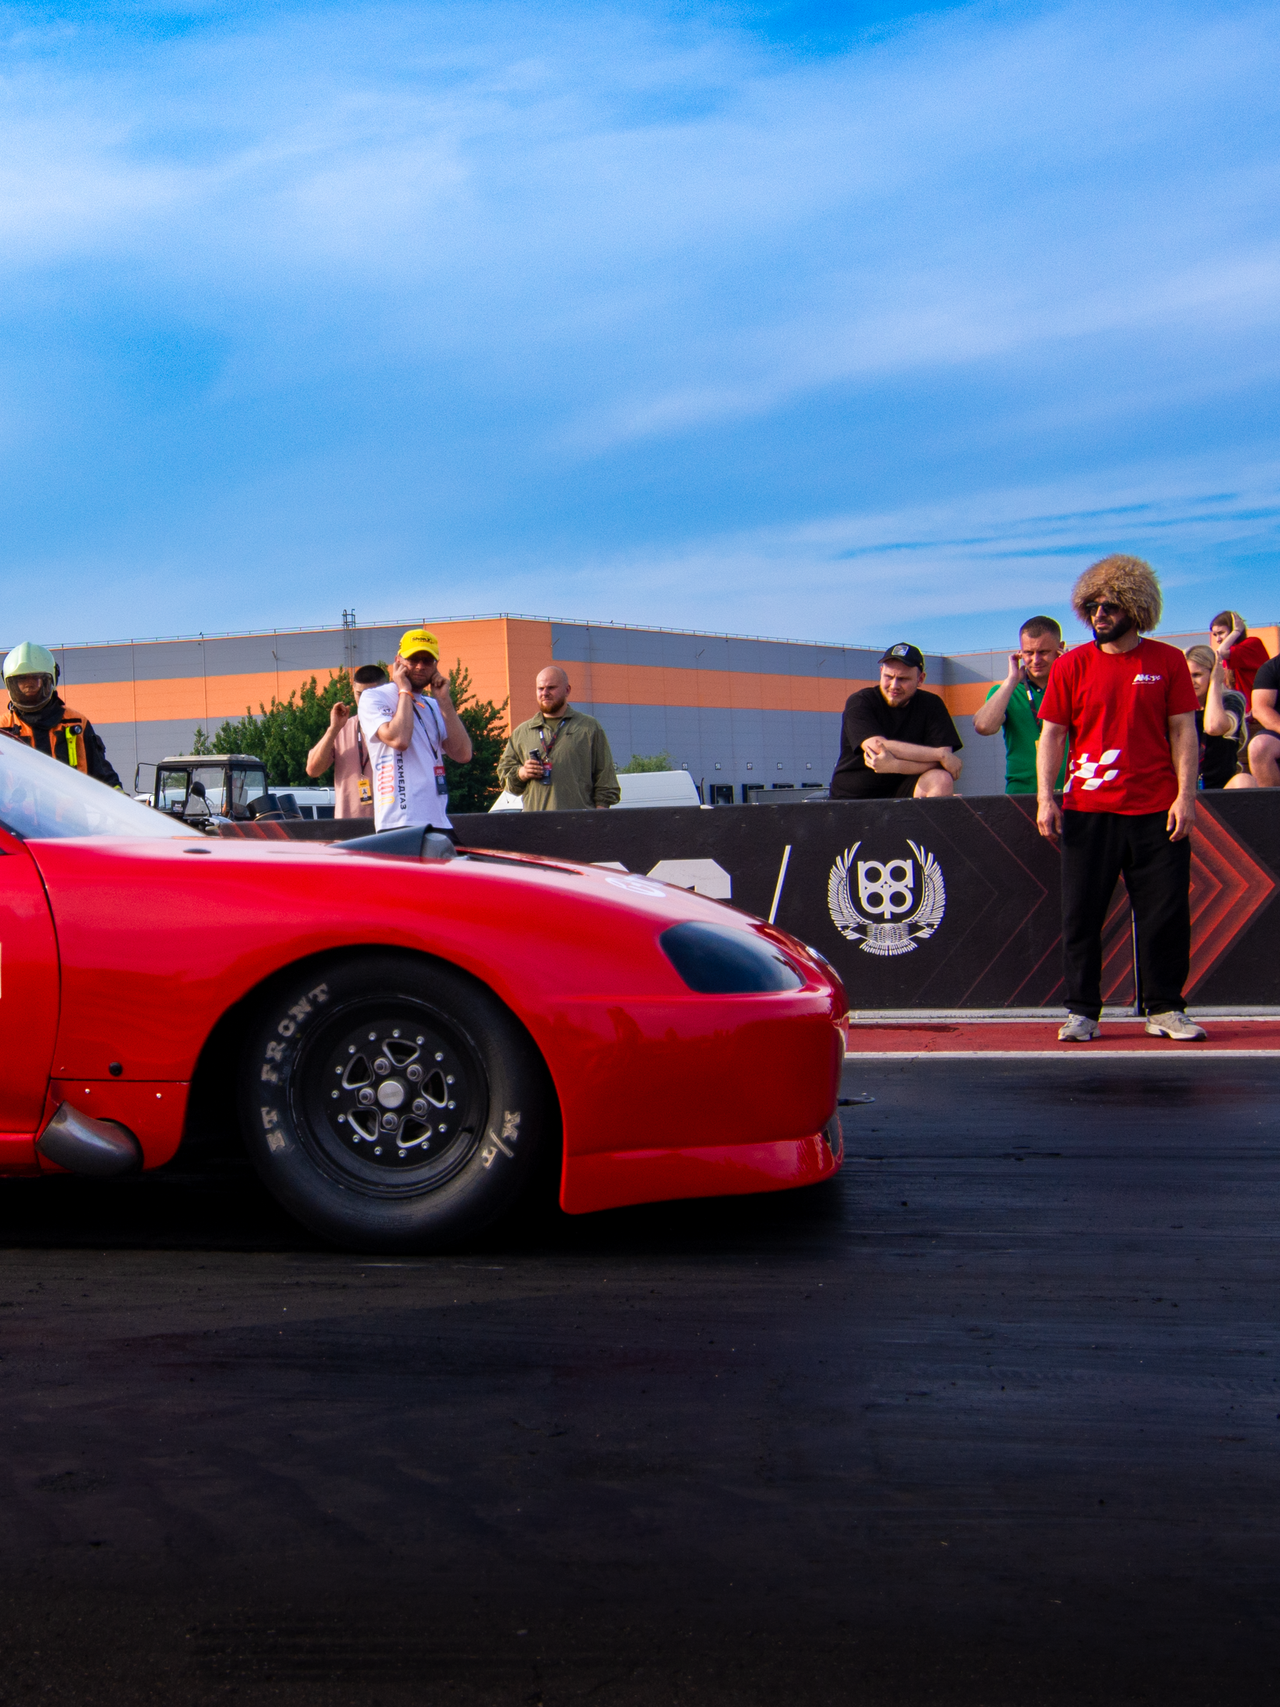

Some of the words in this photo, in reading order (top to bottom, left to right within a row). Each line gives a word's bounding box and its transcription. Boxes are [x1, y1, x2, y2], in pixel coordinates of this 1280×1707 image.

[396, 752, 407, 810] ТЕХМЕДГАЗ
[261, 983, 328, 1083] FRONT
[260, 1106, 286, 1151] ET
[481, 1110, 520, 1169] M/T
